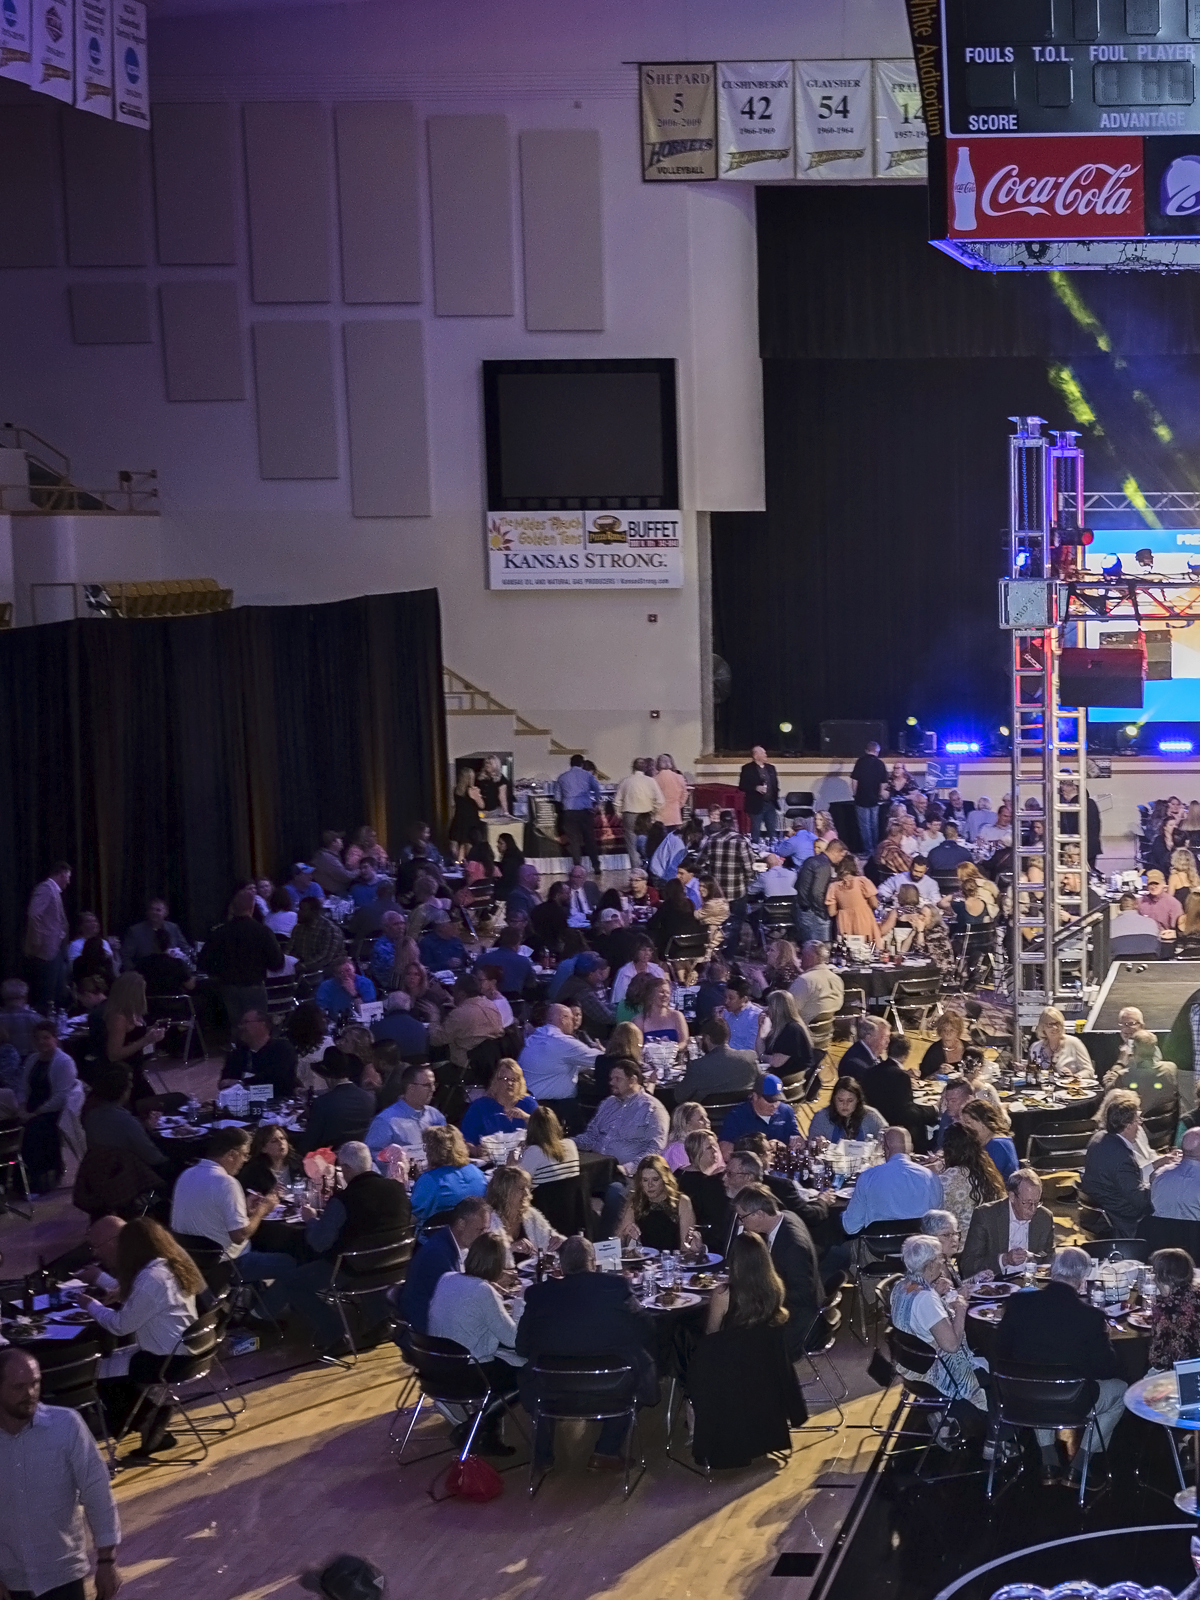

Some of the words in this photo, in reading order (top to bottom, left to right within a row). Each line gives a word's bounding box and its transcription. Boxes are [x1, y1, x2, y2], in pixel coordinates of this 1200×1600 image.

[911, 0, 937, 37] hite
[965, 47, 1014, 63] FOULS
[1032, 46, 1074, 62] T.O.L.
[1089, 46, 1127, 61] FOUL
[1137, 44, 1196, 60] PLAYER
[645, 69, 710, 86] SHEPARD
[806, 80, 861, 89] GLAYSHER
[917, 44, 943, 136] Auditorium
[672, 93, 684, 113] 5
[740, 96, 773, 121] 42
[818, 95, 850, 120] 54
[968, 114, 1018, 131] SCORE
[1100, 112, 1186, 129] ADVANTAGE
[656, 165, 705, 175] VOLLEYBALL
[981, 163, 1142, 217] Coca-Cola
[628, 521, 679, 538] BUFFET
[503, 554, 580, 569] KANSAS
[584, 553, 668, 568] STRONG.
[252, 1107, 262, 1115] 33
